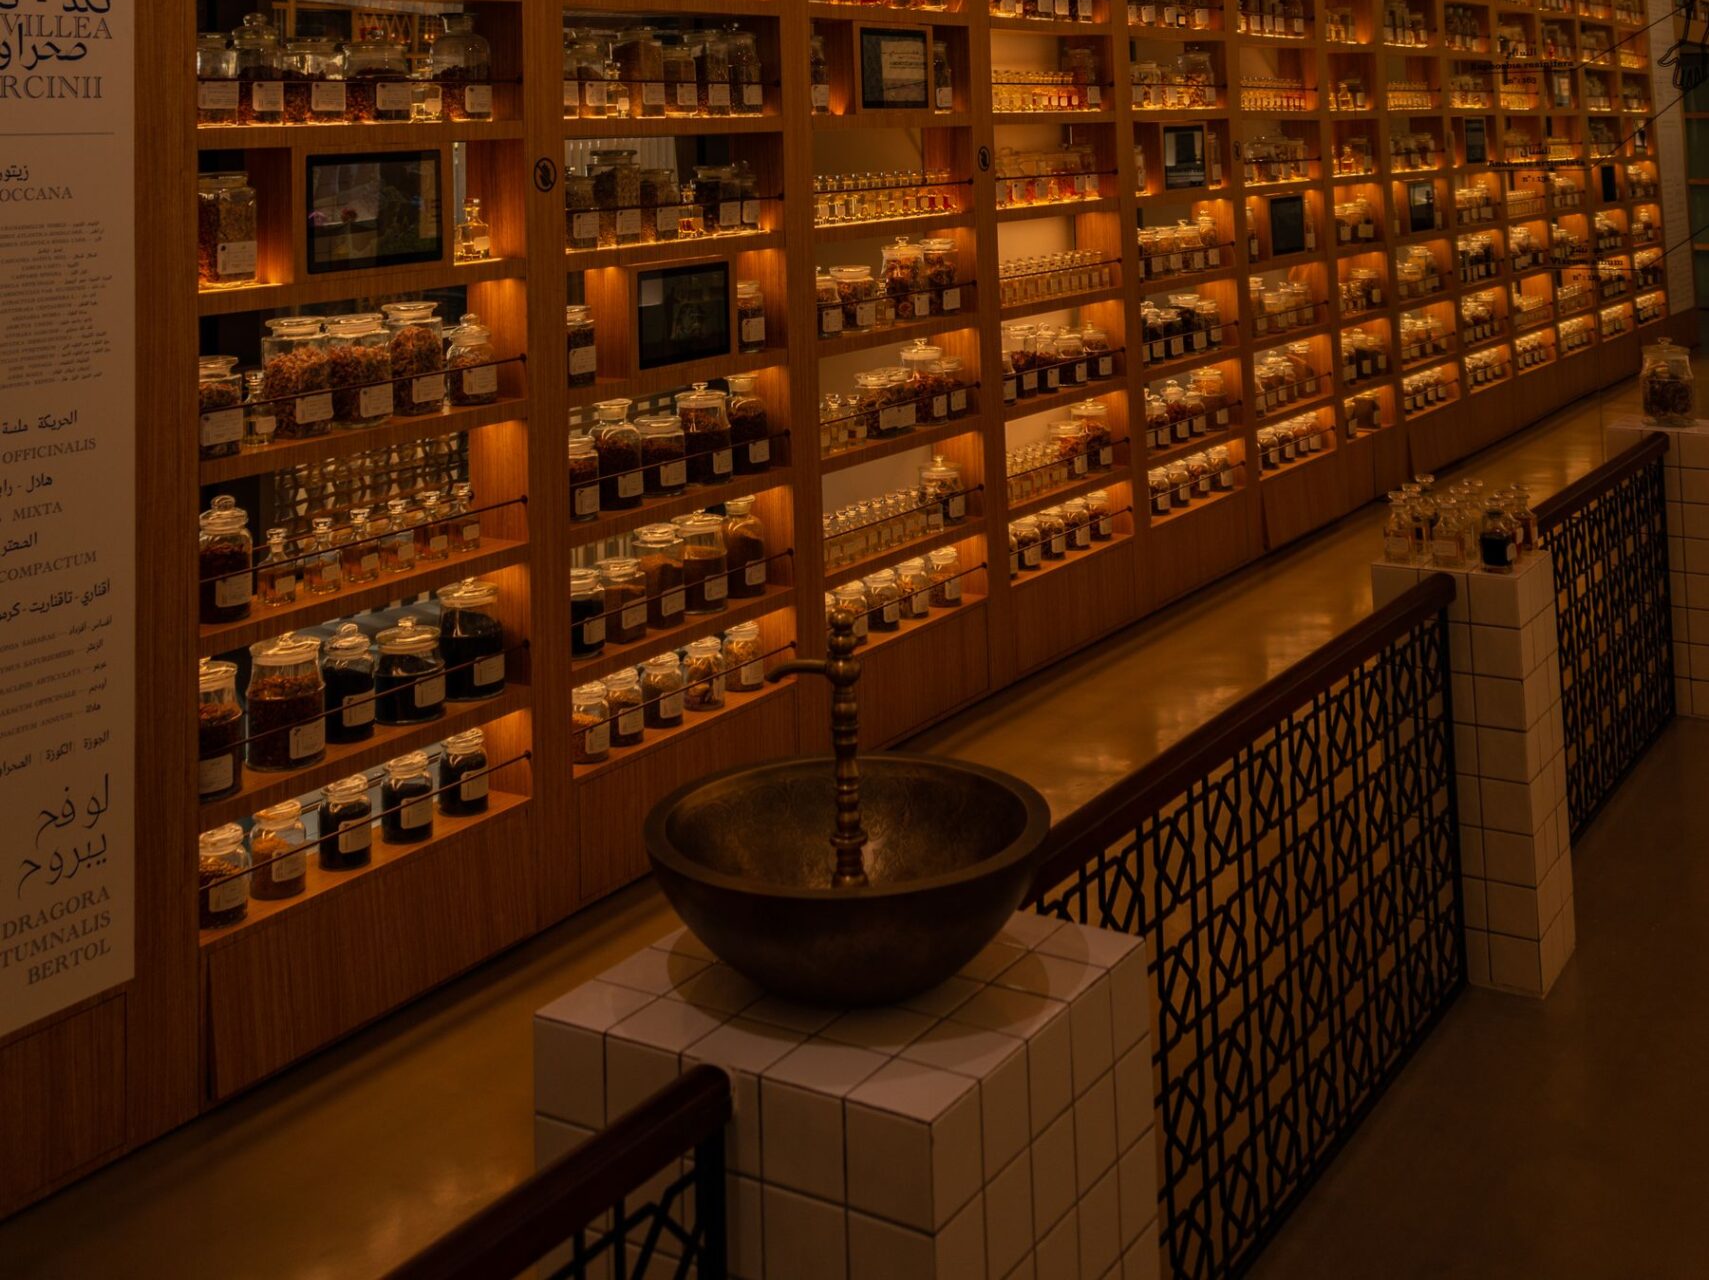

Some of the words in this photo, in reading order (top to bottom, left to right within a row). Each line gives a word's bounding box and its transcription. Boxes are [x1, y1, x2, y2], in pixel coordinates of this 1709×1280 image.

[2, 438, 97, 464] OFFICINALIS
[12, 501, 63, 521] MIXTA
[2, 885, 110, 940] DRAGORA
[28, 938, 111, 985] BERTOL
